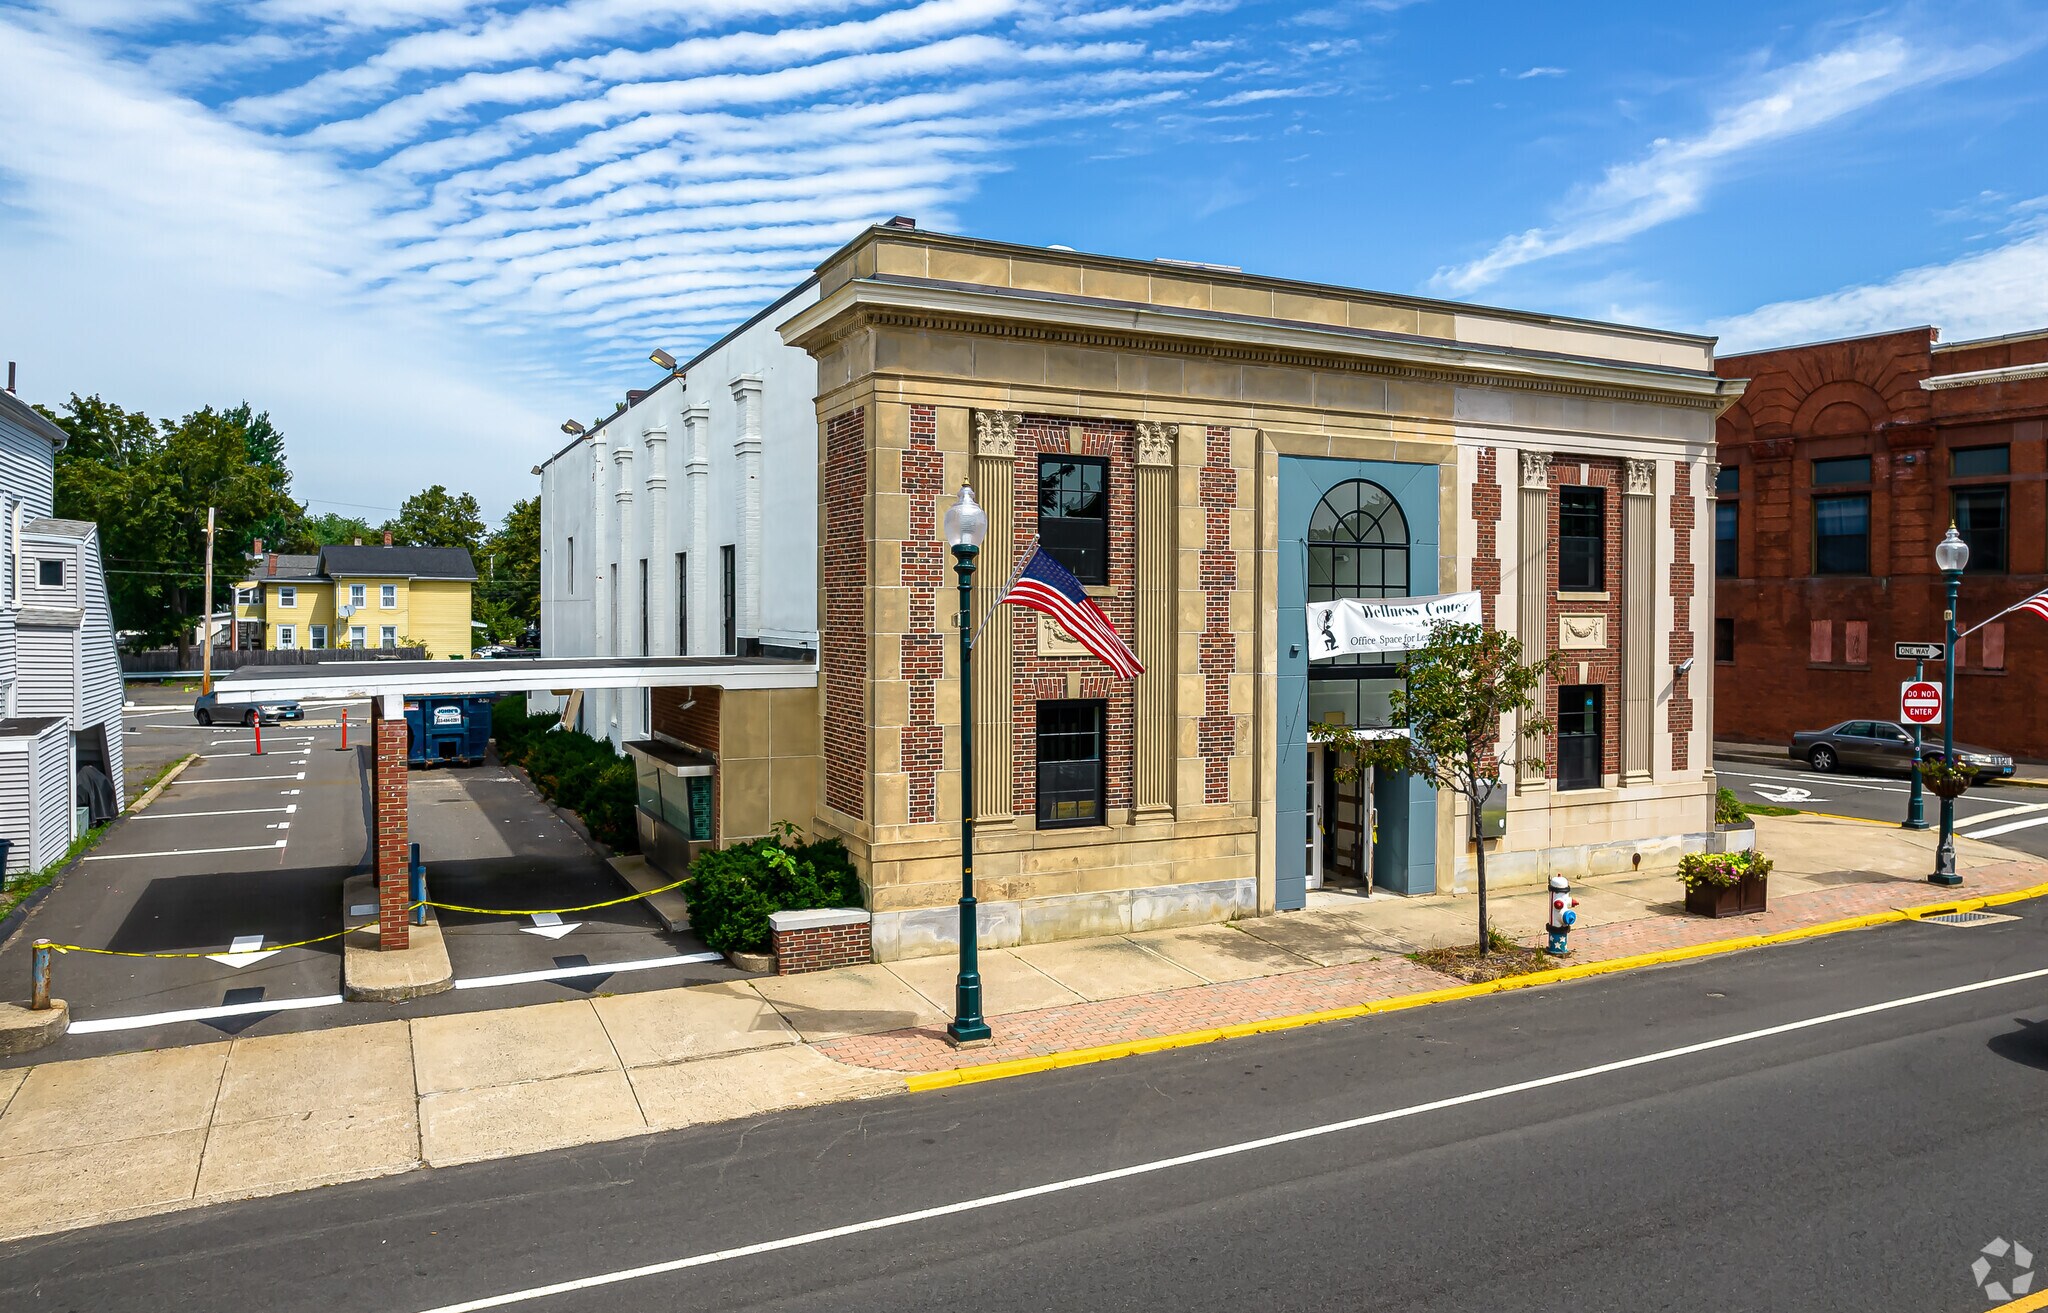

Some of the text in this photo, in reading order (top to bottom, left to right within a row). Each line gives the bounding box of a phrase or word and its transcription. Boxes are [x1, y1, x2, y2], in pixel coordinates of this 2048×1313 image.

[1362, 602, 1469, 618] Wellness Center
[1350, 636, 1376, 646] Office
[1380, 634, 1402, 646] Space
[1403, 633, 1415, 644] for
[1900, 647, 1914, 655] ONE
